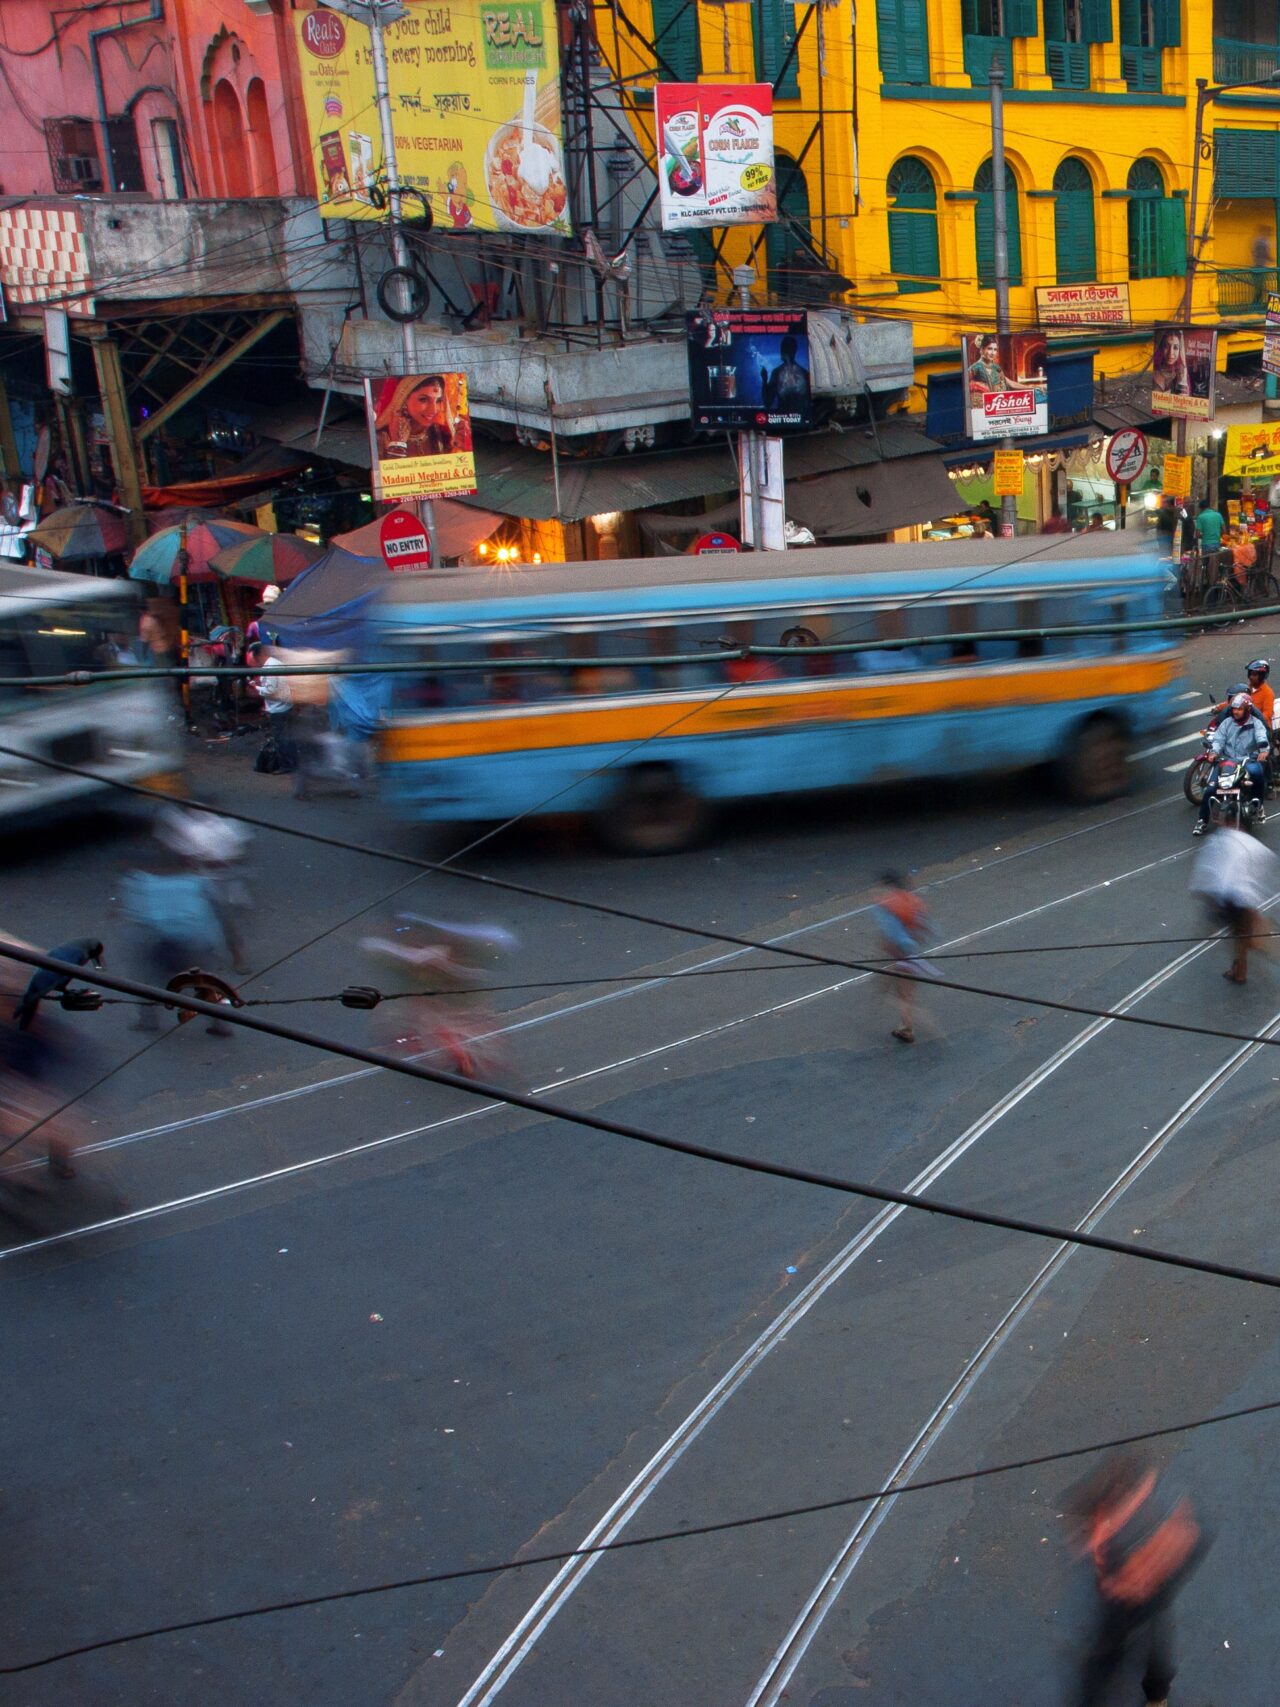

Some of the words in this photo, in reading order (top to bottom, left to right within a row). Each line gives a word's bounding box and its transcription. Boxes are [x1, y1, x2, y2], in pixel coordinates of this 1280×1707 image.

[307, 14, 341, 46] Real's
[396, 19, 420, 40] your
[425, 8, 451, 35] child
[483, 9, 543, 48] REAL
[391, 46, 421, 68] every
[425, 40, 476, 67] morning
[488, 77, 509, 86] CORN
[510, 77, 535, 86] FLAKES
[395, 136, 411, 150] 00%
[412, 136, 463, 152] VEGETARIAN
[708, 139, 732, 151] CORN
[732, 138, 759, 151] FLAKES
[745, 166, 763, 181] 99%
[755, 174, 769, 186] FREE
[680, 210, 692, 218] KLC
[693, 208, 714, 217] AGENCY
[715, 208, 727, 216] PVT.
[1047, 289, 1082, 302] সারদা
[1085, 309, 1123, 321] TRADERS
[985, 394, 1031, 412] Ashok
[783, 416, 801, 424] TODAY
[1012, 416, 1032, 425] Young
[382, 472, 415, 487] Madanji
[416, 470, 451, 484] Meghraj
[453, 469, 460, 478] &
[386, 541, 398, 554] NO
[400, 537, 425, 551] ENTRY
